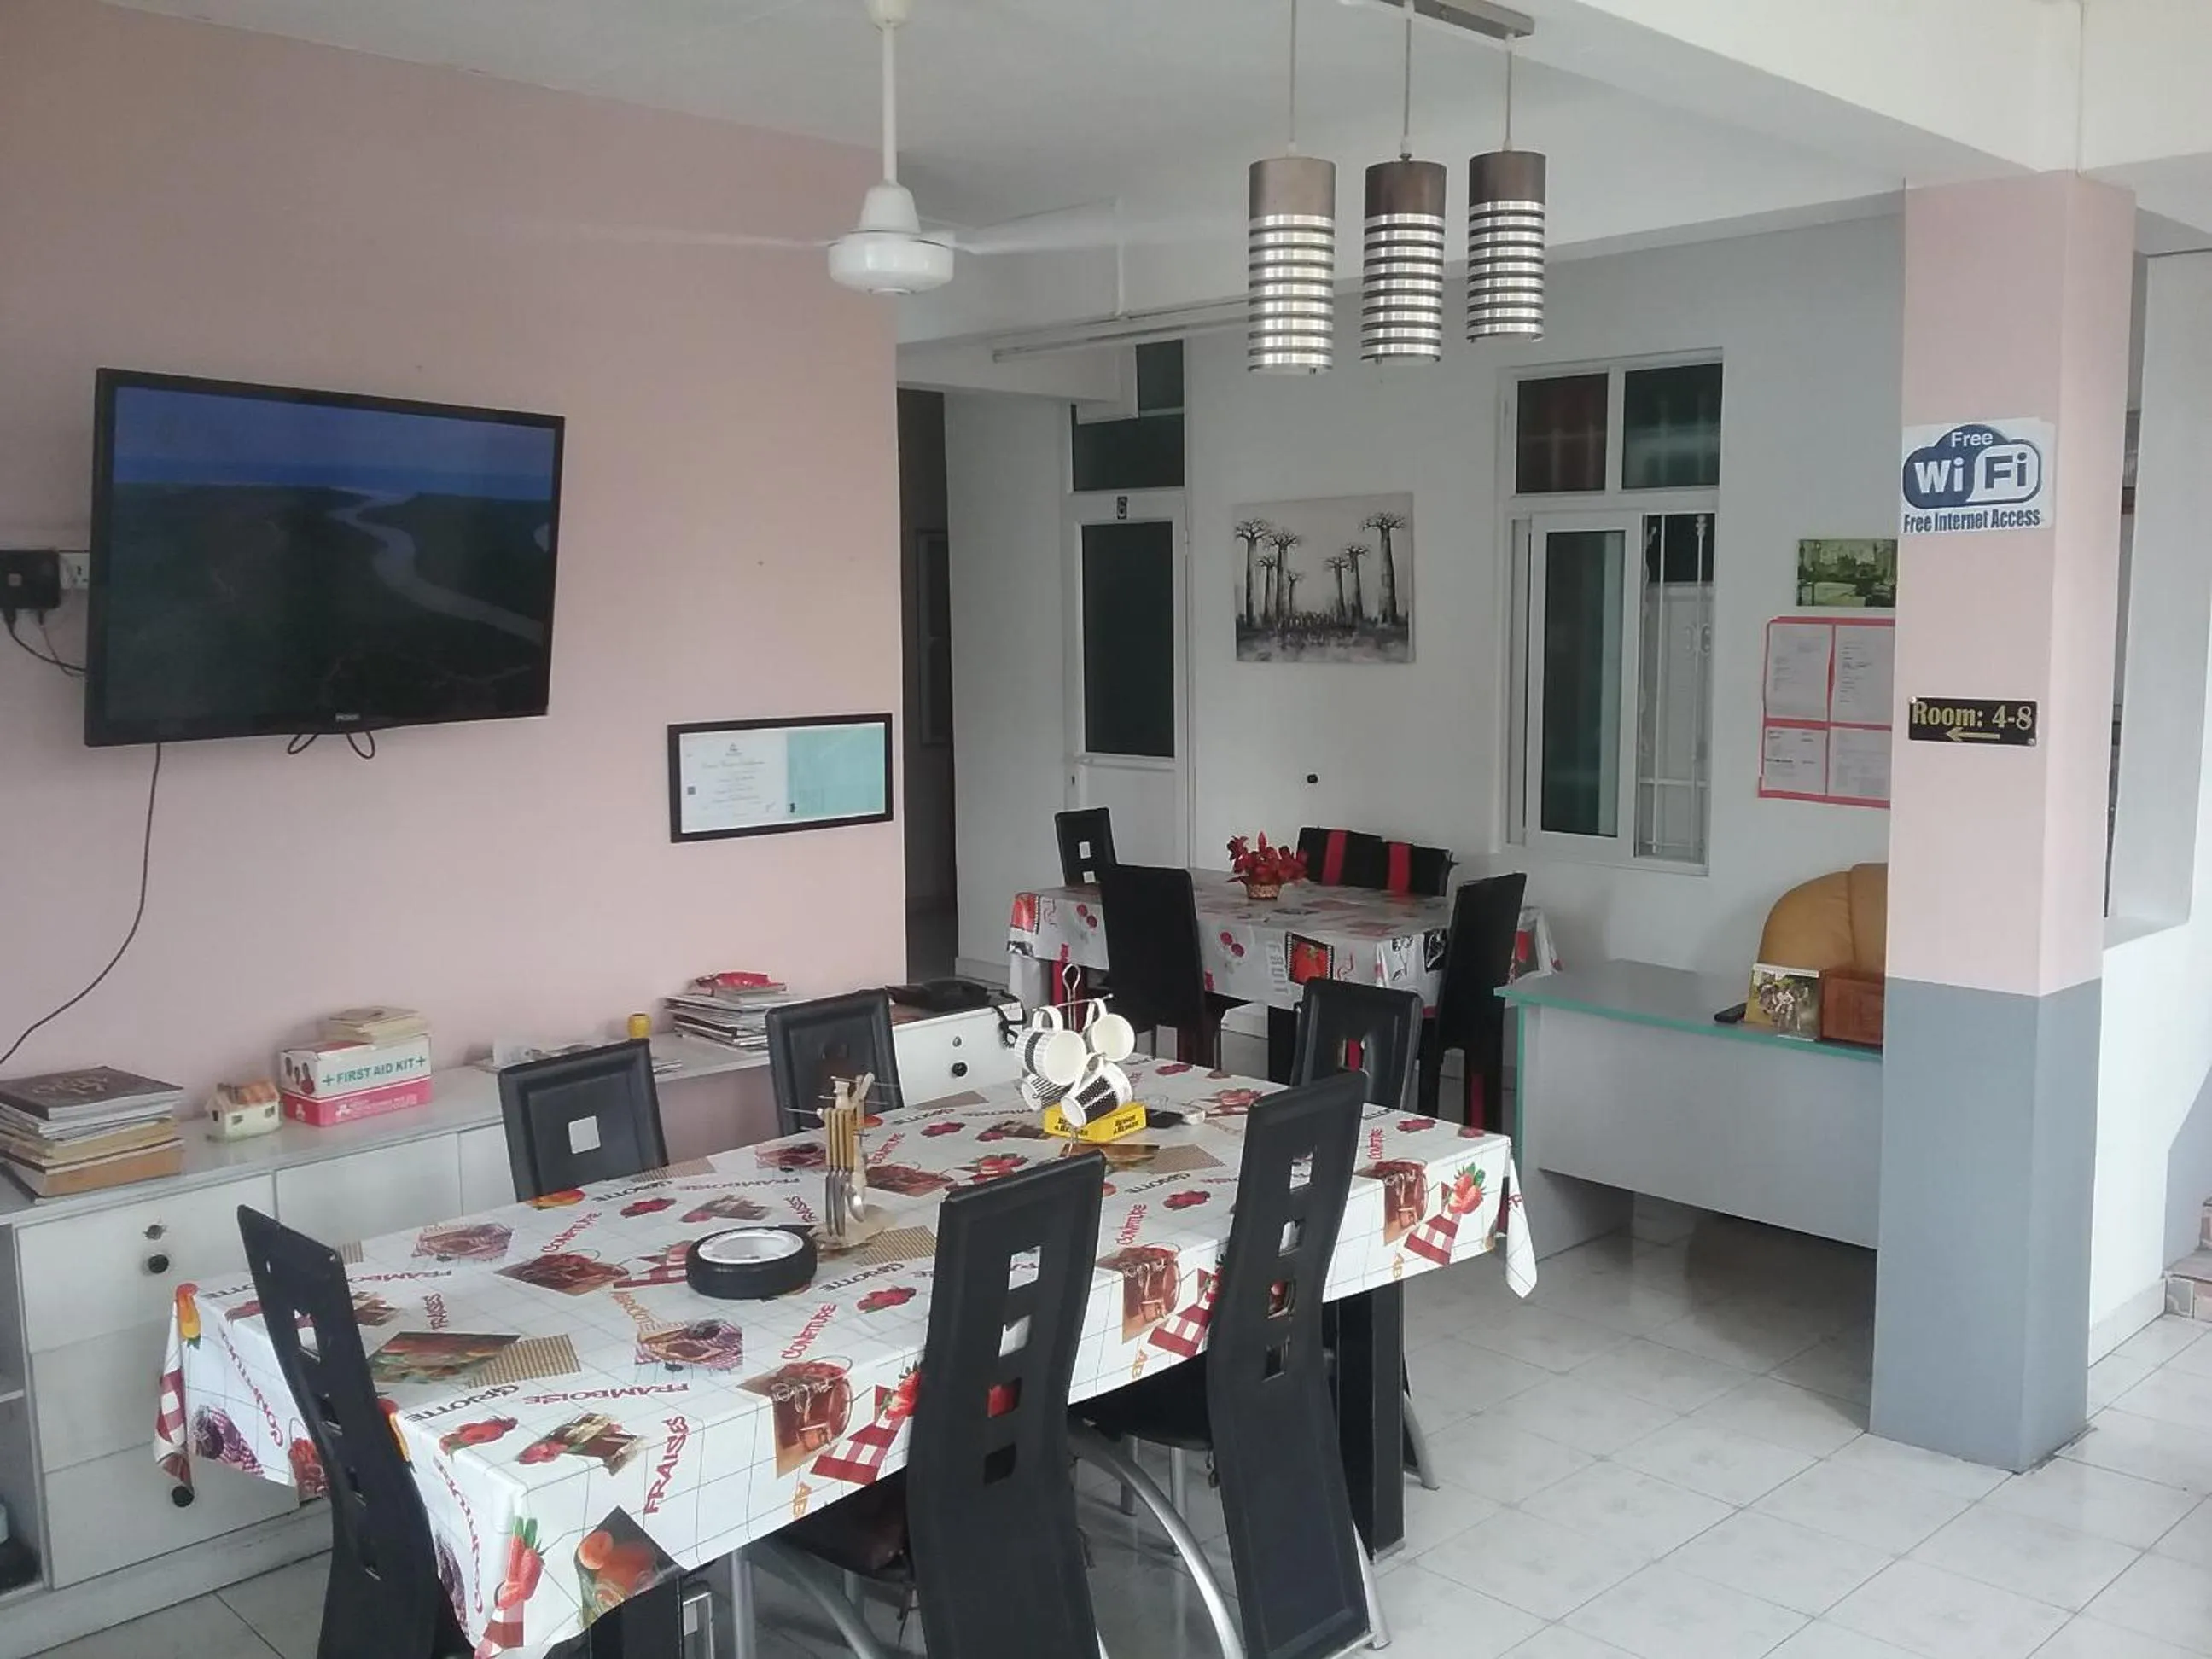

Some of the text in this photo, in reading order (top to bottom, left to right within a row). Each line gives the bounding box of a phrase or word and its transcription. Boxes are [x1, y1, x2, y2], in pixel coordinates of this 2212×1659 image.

[1951, 431, 1993, 447] Free
[1903, 509, 2040, 533] Free Internet Access
[1912, 701, 2033, 731] Room: 4-8
[336, 1058, 415, 1085] FIRST AID KIT
[405, 1384, 519, 1423] GRIOTTE
[523, 1382, 690, 1406] FRAMBOISE
